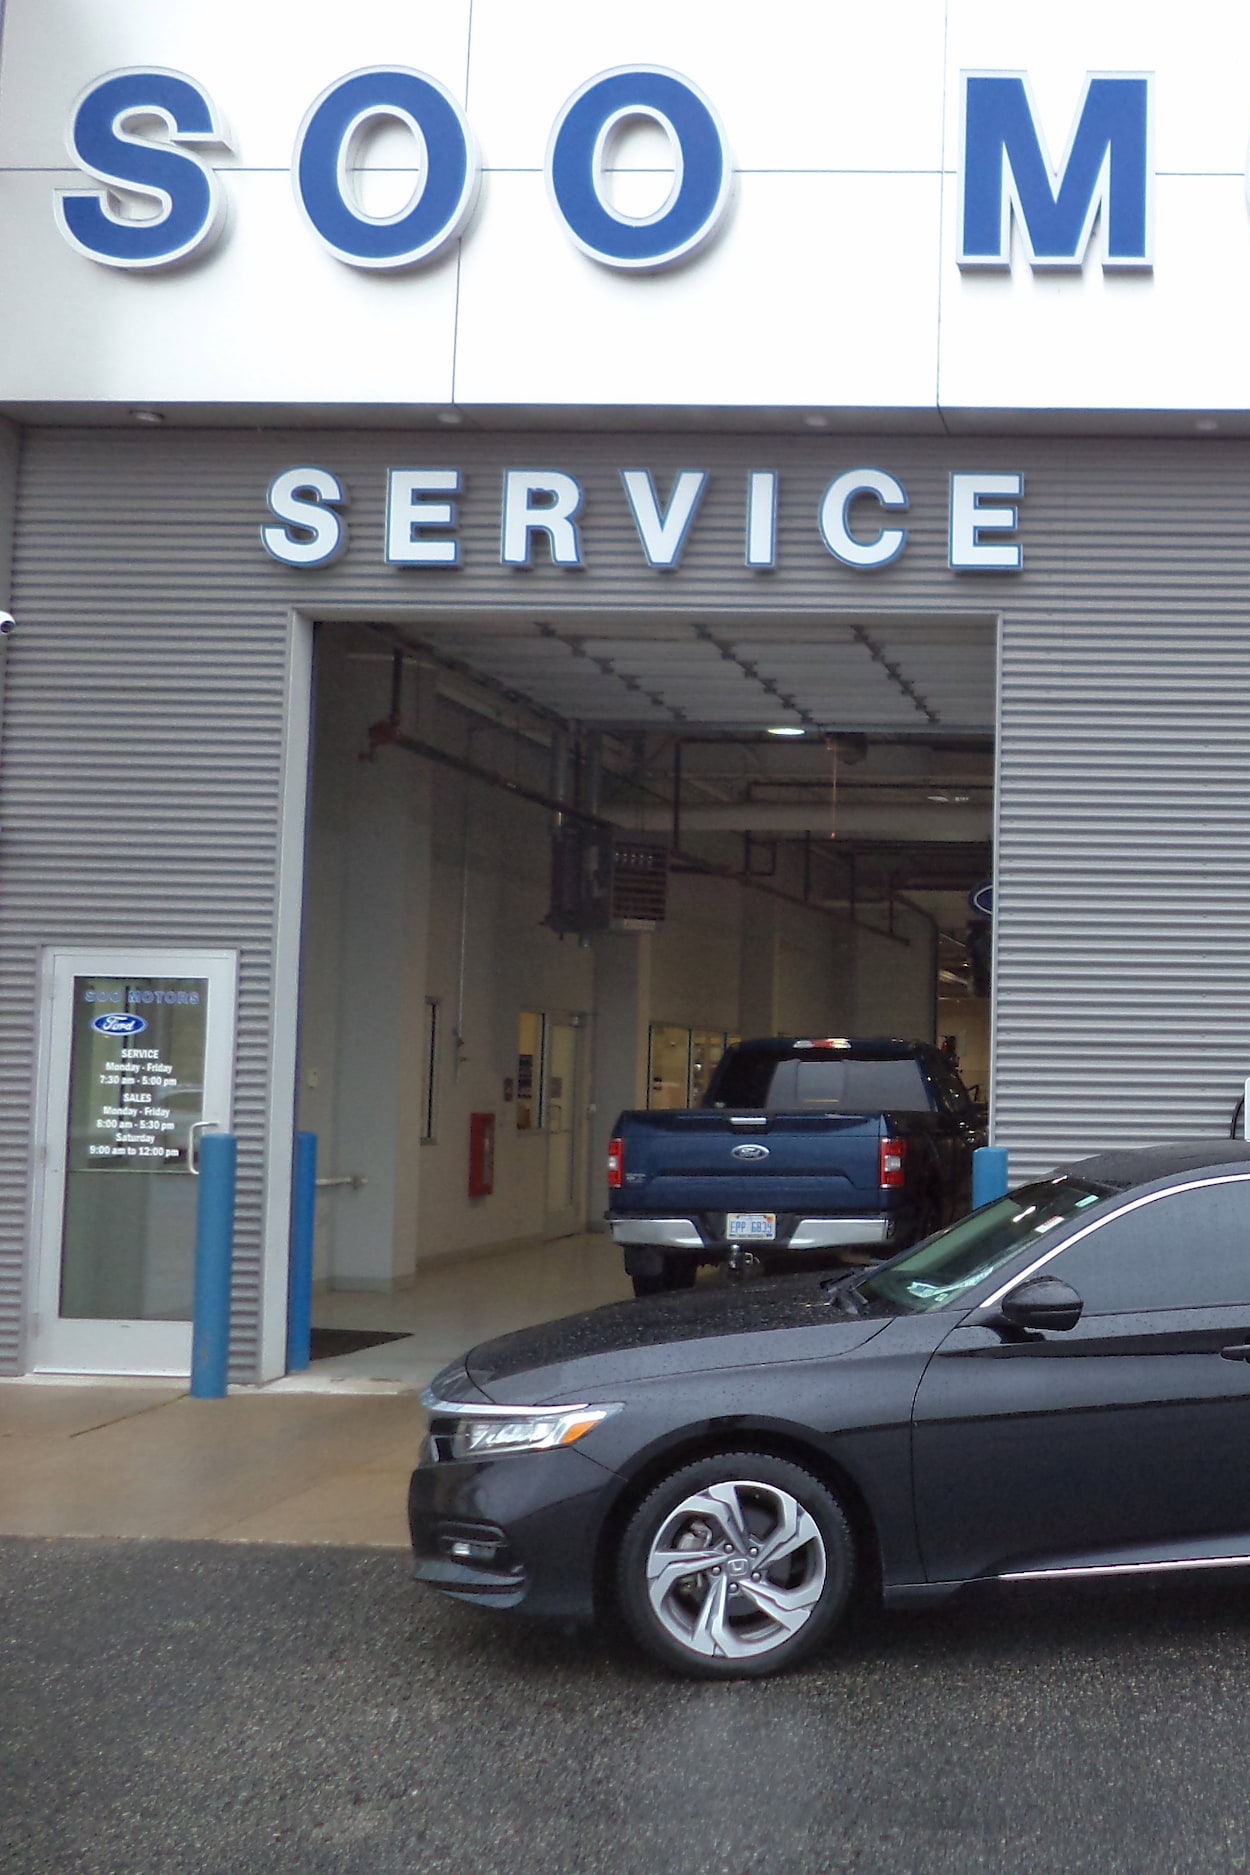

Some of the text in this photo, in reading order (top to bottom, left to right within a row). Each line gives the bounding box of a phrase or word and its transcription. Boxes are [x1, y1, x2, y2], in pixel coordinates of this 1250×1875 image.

[54, 64, 735, 272] SOO
[260, 467, 1025, 571] SERVICE
[84, 989, 200, 1005] SOO MOTORS
[102, 1016, 135, 1031] Ford
[121, 1049, 160, 1059] SERVICE
[105, 1062, 141, 1073] Monday
[146, 1062, 173, 1074] Friday
[100, 1075, 120, 1084] 7:30
[121, 1077, 135, 1085] am
[142, 1076, 162, 1085] 5:00
[163, 1078, 177, 1087] pm
[123, 1093, 152, 1103] SALES
[103, 1106, 138, 1117] Monday
[144, 1106, 170, 1118] Friday
[118, 1121, 133, 1129] am
[139, 1120, 160, 1129] 5:30
[161, 1122, 175, 1131] pm
[116, 1132, 155, 1144] Saturday
[89, 1145, 179, 1157] 9:00 am to 12:00 pm
